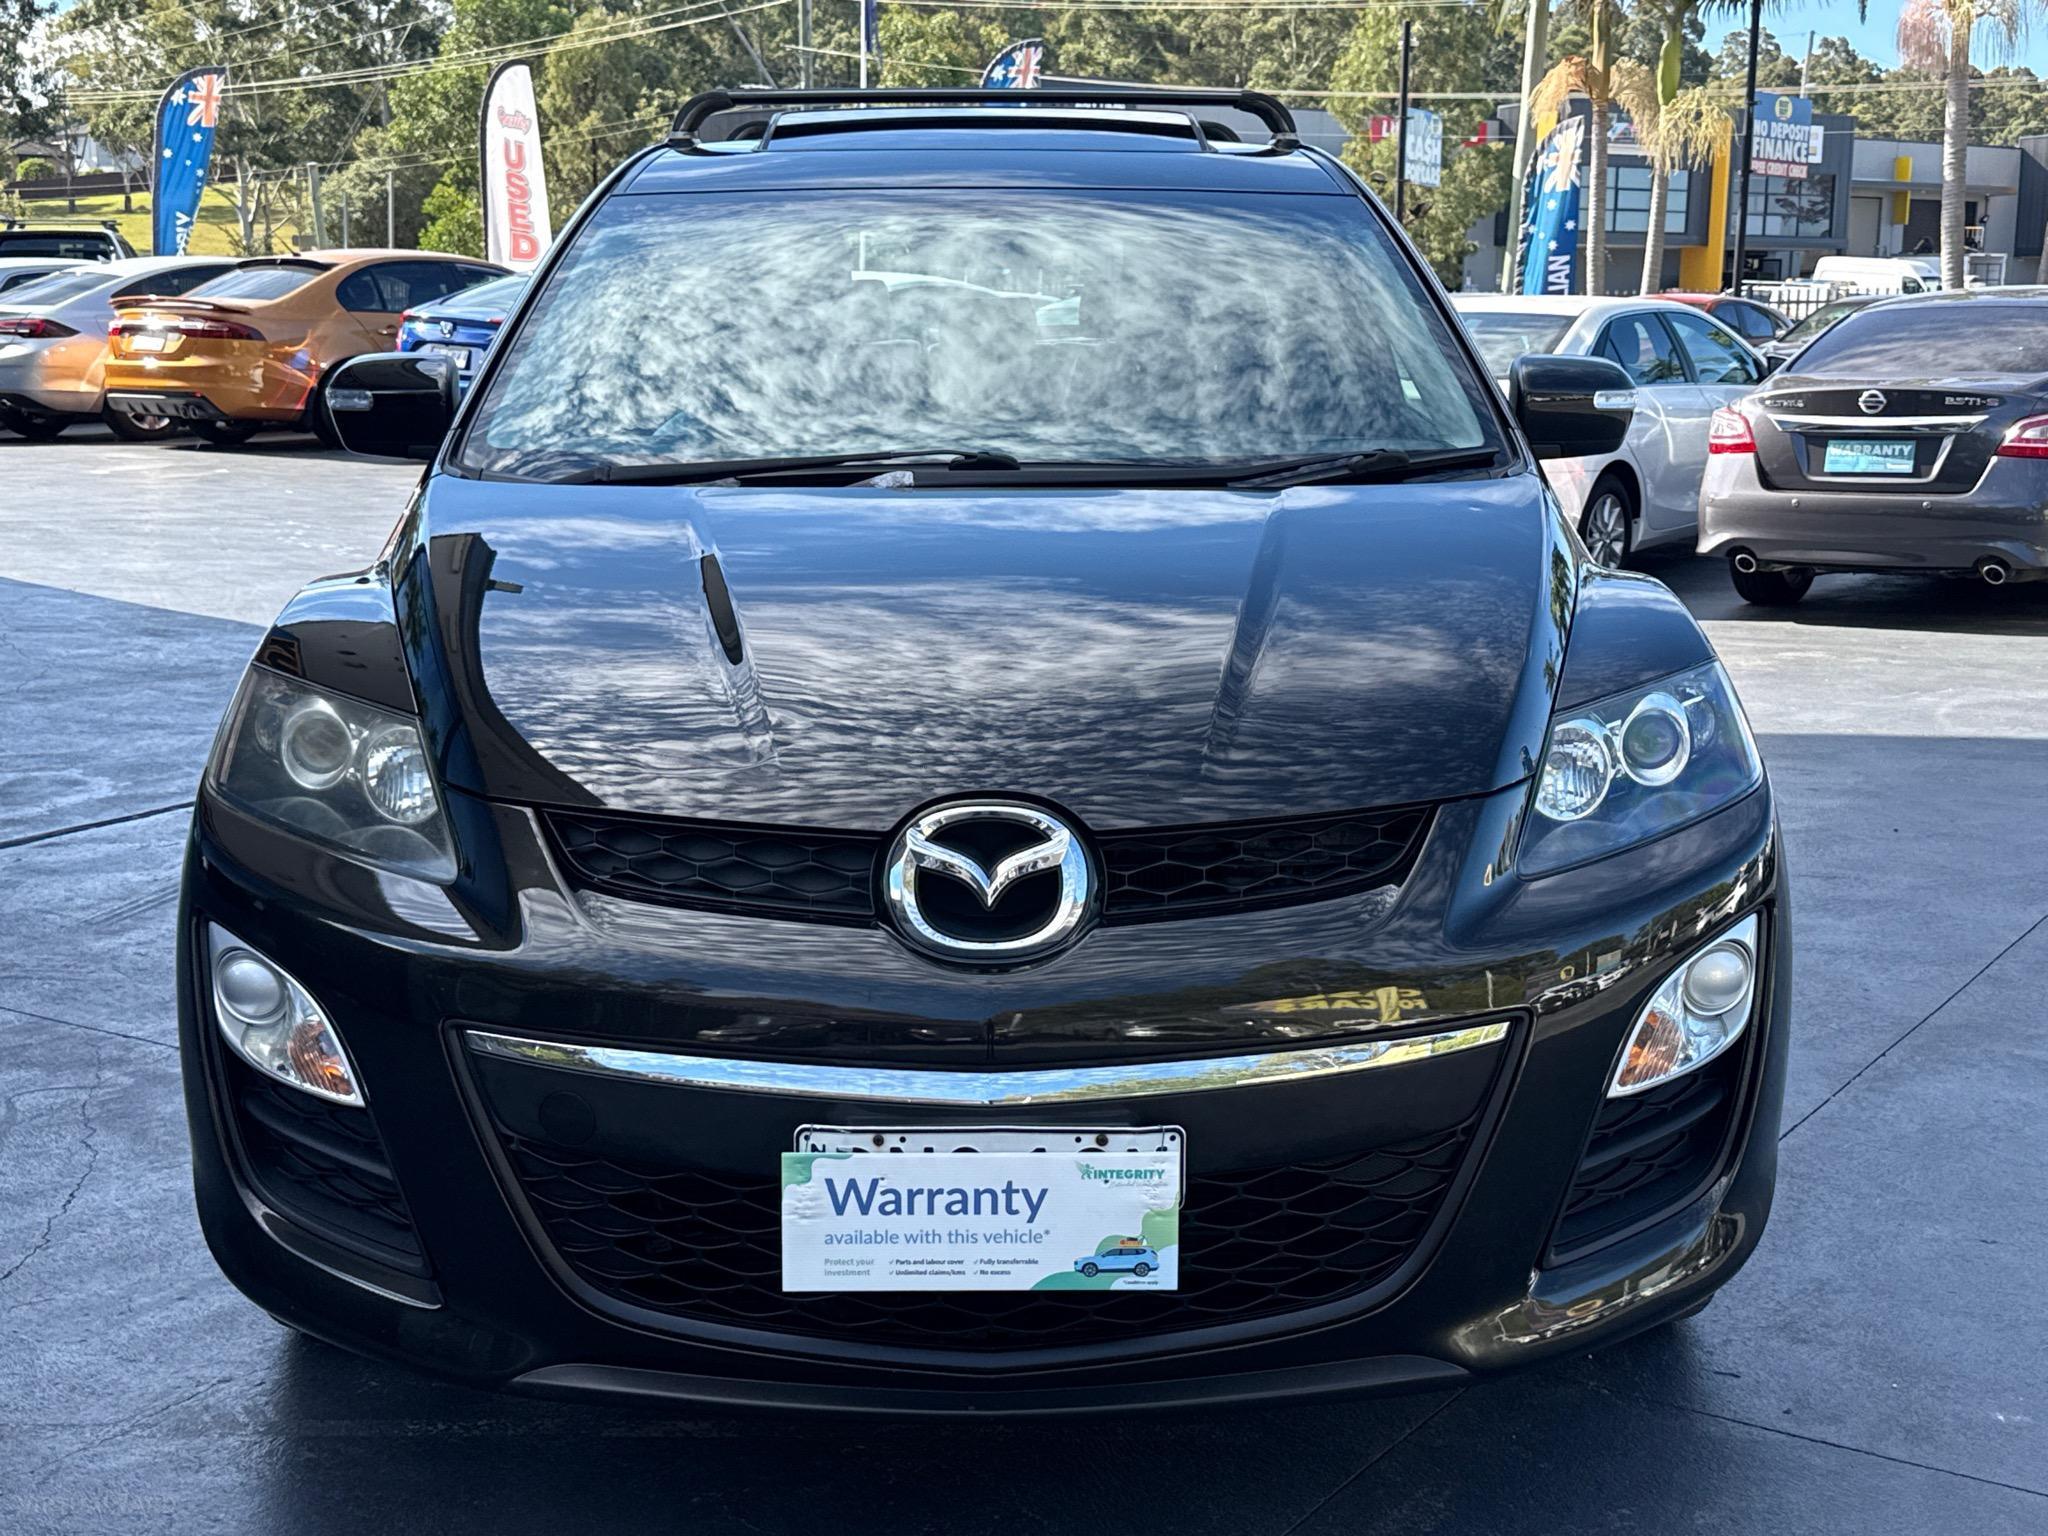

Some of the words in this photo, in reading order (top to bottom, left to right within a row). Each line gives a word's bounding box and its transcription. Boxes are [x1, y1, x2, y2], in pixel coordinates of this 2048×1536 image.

[1753, 120, 1768, 136] NO
[1770, 121, 1809, 141] DEPOSIT
[1406, 134, 1441, 166] CASH
[1752, 137, 1808, 164] FINANCE
[503, 136, 541, 262] USED
[1829, 444, 1913, 456] WARRANTY
[1093, 1169, 1165, 1180] INTEGRITY
[824, 1177, 1049, 1224] Warranty
[824, 1229, 899, 1245] available
[904, 1229, 942, 1244] with
[947, 1229, 978, 1244] this
[824, 1258, 854, 1266] Protect
[856, 1259, 874, 1267] your
